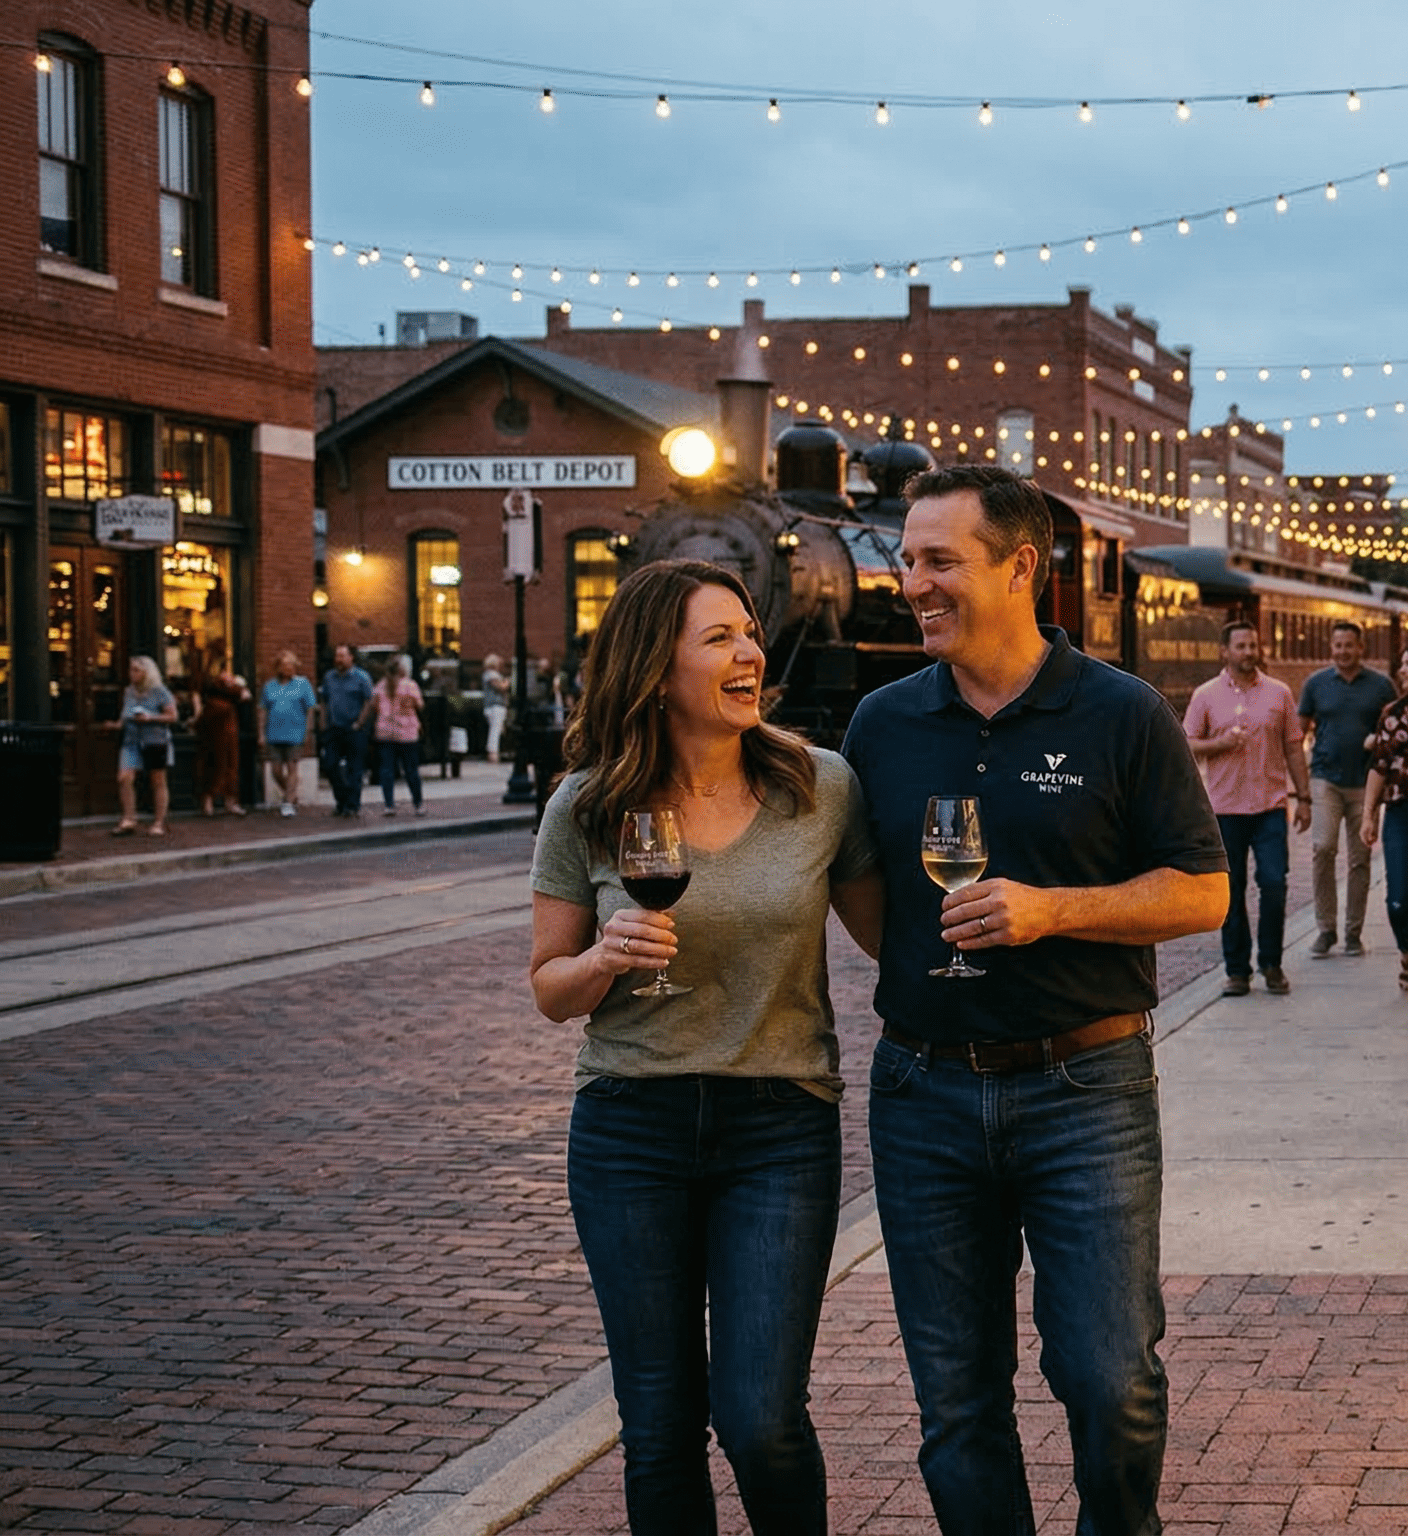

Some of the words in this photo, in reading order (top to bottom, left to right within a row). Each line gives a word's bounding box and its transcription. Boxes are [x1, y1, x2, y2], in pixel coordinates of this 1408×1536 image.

[397, 461, 482, 482] COTTON
[492, 461, 545, 482] BELT
[554, 461, 626, 482] DEPOT
[1020, 770, 1085, 786] GRAPEVINE
